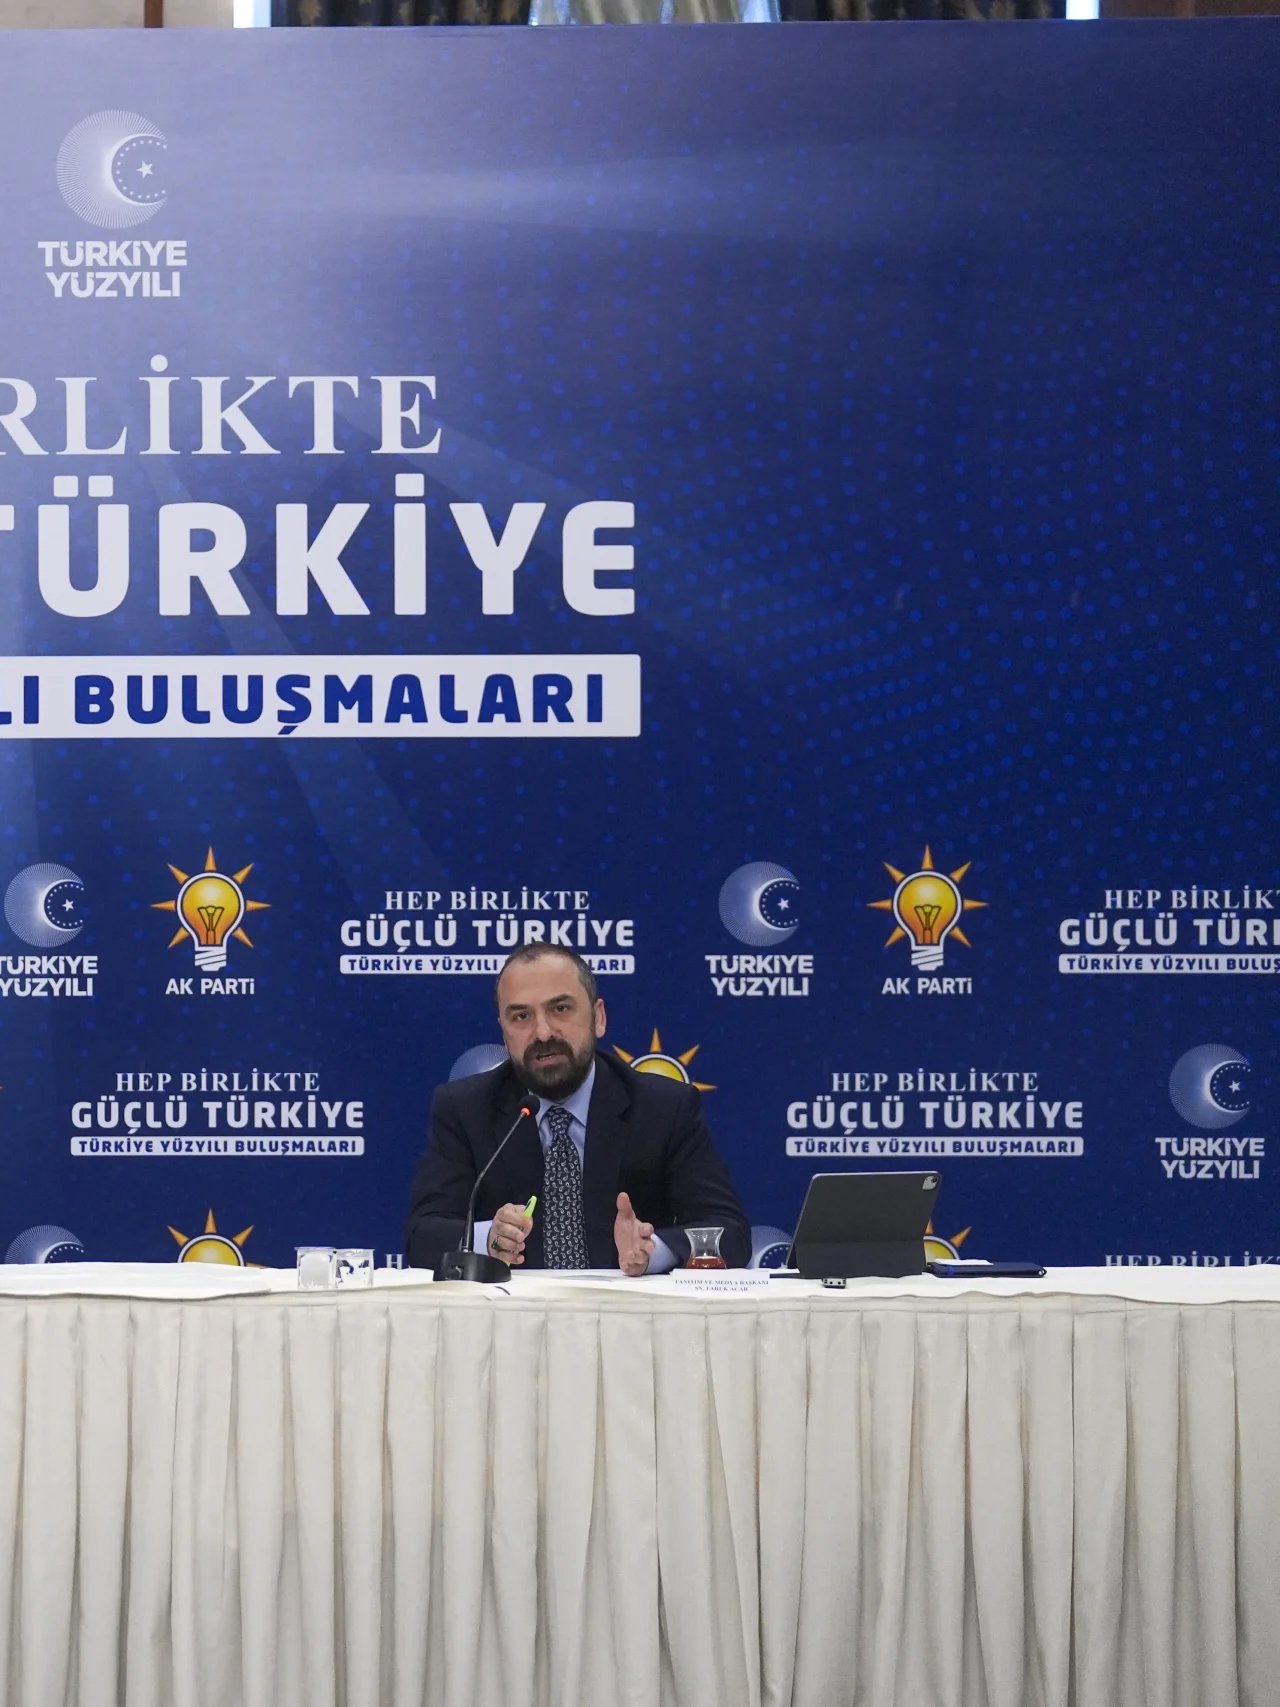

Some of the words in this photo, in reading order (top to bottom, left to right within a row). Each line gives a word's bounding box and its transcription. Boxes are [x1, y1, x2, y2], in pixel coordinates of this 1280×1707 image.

[75, 674, 602, 735] BULUŞMALARI
[386, 892, 440, 909] HEP
[451, 887, 588, 909] BİRLİKTE
[1106, 890, 1161, 908] HEP
[341, 914, 456, 952] GÜÇLÜ
[472, 914, 633, 946] TÜRKİYE
[1060, 913, 1177, 951] GÜÇLÜ
[349, 957, 422, 970] TÜRKİYE
[430, 957, 497, 970] YÜZYILI
[1068, 955, 1142, 970] TÜRKİYE
[1151, 955, 1218, 970] YÜZYILI
[166, 979, 193, 994] AK
[882, 978, 909, 994] AK
[117, 1073, 171, 1091] HEP
[182, 1068, 319, 1091] BİRLİKTE
[833, 1073, 887, 1091] HEP
[899, 1068, 1037, 1091] BİRLİKTE
[72, 1095, 187, 1134] GÜÇLÜ
[203, 1095, 363, 1128] TÜRKİYE
[787, 1096, 903, 1134] GÜÇLÜ
[920, 1095, 1082, 1128] TÜRKİYE
[79, 1138, 152, 1152] TÜRKİYE
[161, 1138, 227, 1152] YÜZYILI
[236, 1141, 355, 1155] BULUŞMALARI
[795, 1139, 869, 1153] TÜRKİYE
[877, 1139, 944, 1153] YÜZYILI
[953, 1141, 1074, 1156] BULUŞMALARI
